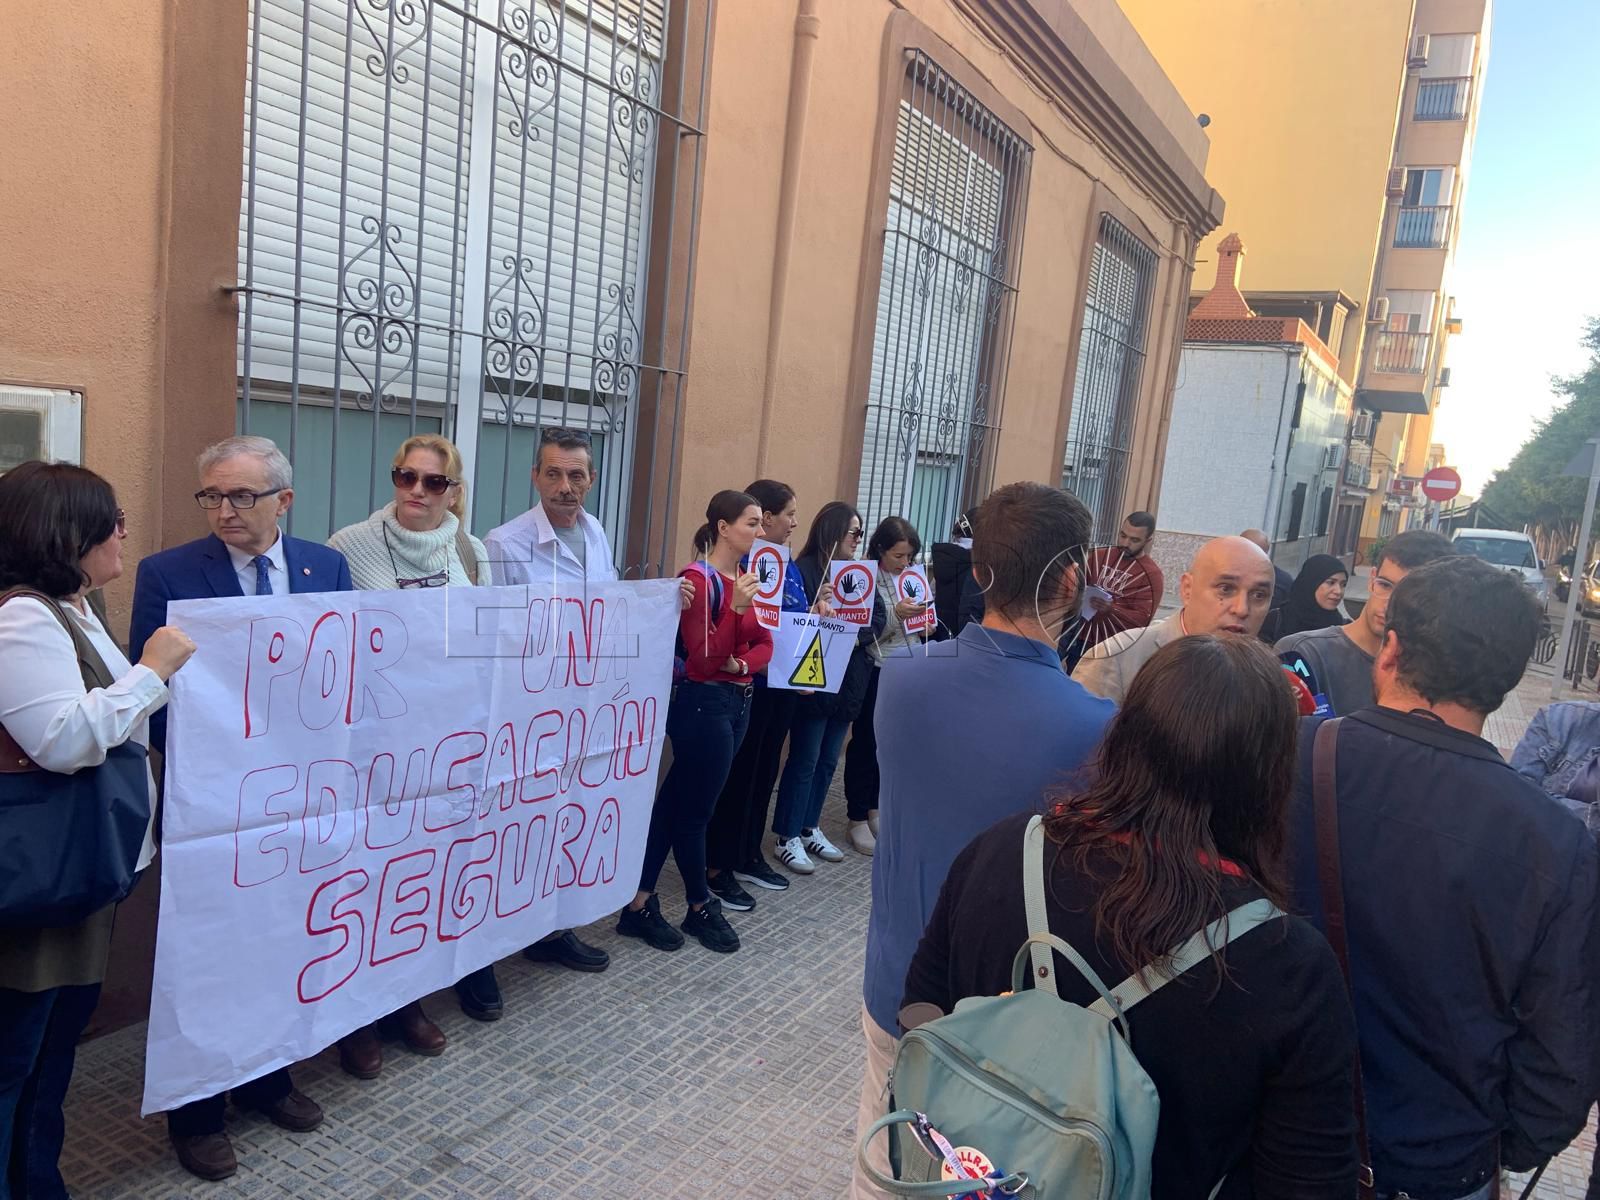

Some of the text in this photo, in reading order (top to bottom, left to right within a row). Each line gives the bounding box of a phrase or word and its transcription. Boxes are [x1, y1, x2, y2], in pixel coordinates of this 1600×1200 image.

[244, 596, 630, 738] POR UNA
[792, 617, 806, 626] NO
[807, 618, 816, 627] AL
[907, 612, 934, 627] AMIANTO
[233, 685, 656, 888] EDUCACIÓN
[296, 797, 620, 1004] SEGURA
